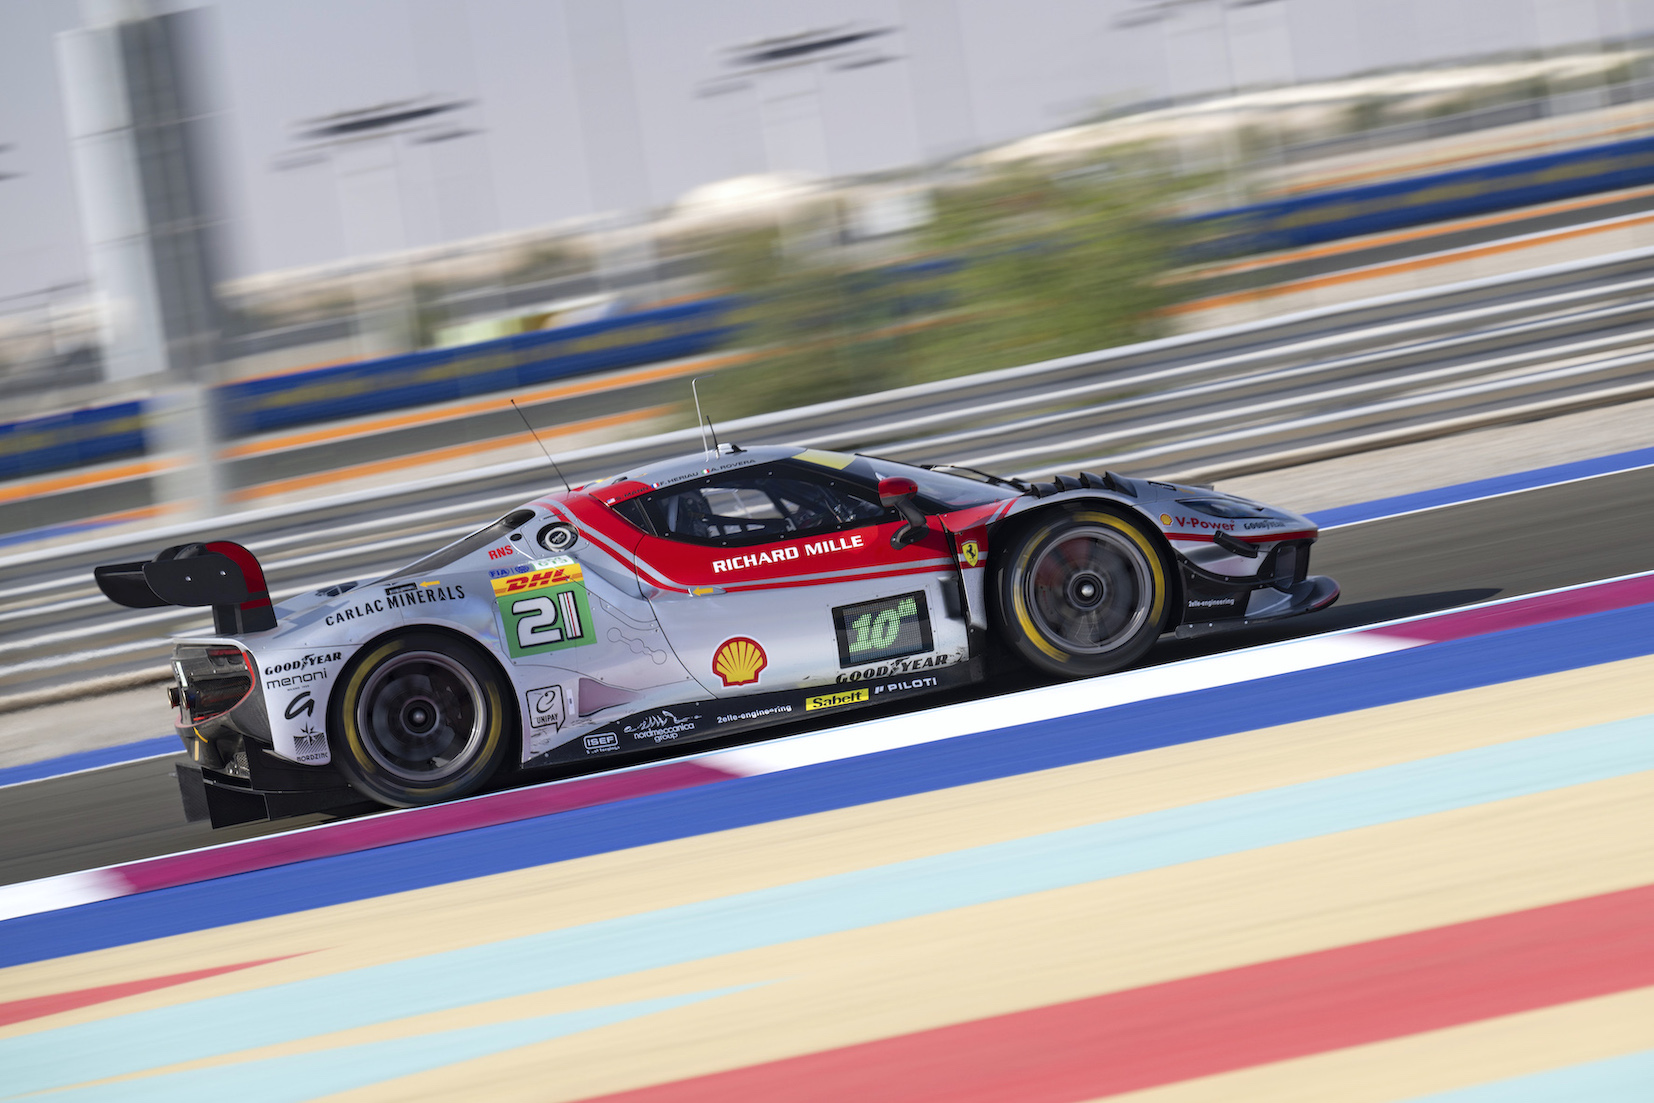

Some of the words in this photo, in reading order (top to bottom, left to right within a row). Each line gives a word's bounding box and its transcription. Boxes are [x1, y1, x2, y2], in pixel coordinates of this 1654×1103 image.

[720, 459, 756, 470] ROVERA
[667, 472, 699, 484] HERIAU
[1175, 516, 1236, 532] V-Power
[488, 545, 514, 560] RNS
[712, 546, 799, 573] RICHARD
[804, 535, 864, 556] MILLE
[490, 568, 509, 578] FIA
[506, 569, 571, 591] DHL
[325, 599, 384, 626] CARLAC
[386, 585, 465, 609] MINERALS
[512, 590, 584, 649] 21
[265, 652, 342, 675] GOODYEAR
[836, 654, 948, 684] GOODYEAR
[266, 668, 328, 689] menoni
[887, 677, 938, 692] PILOTI
[812, 690, 864, 708] Sabelt
[536, 713, 558, 724] UNIPAY
[634, 722, 695, 740] nordmeccanica
[654, 732, 679, 743] group
[587, 736, 615, 747] ISEF
